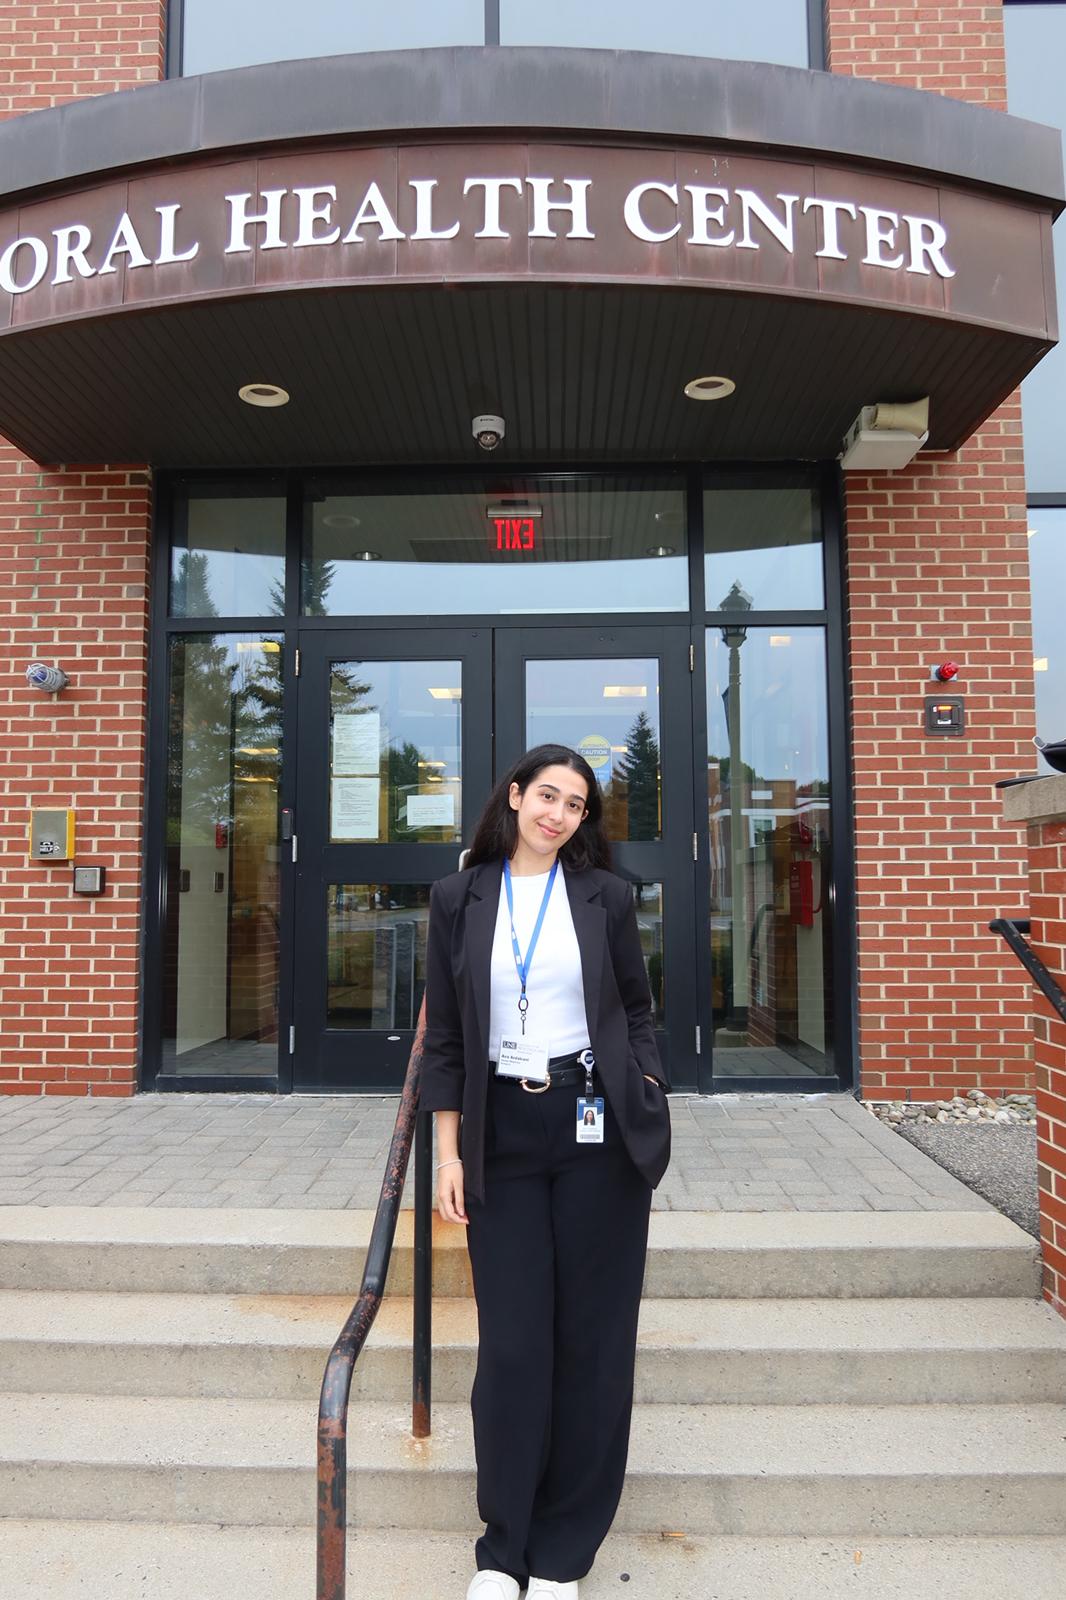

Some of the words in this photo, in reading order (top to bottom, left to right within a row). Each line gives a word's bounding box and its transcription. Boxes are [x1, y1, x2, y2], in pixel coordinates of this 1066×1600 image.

[0, 203, 199, 294] ORAL
[225, 177, 595, 254] HEALTH
[623, 181, 956, 279] CENTER
